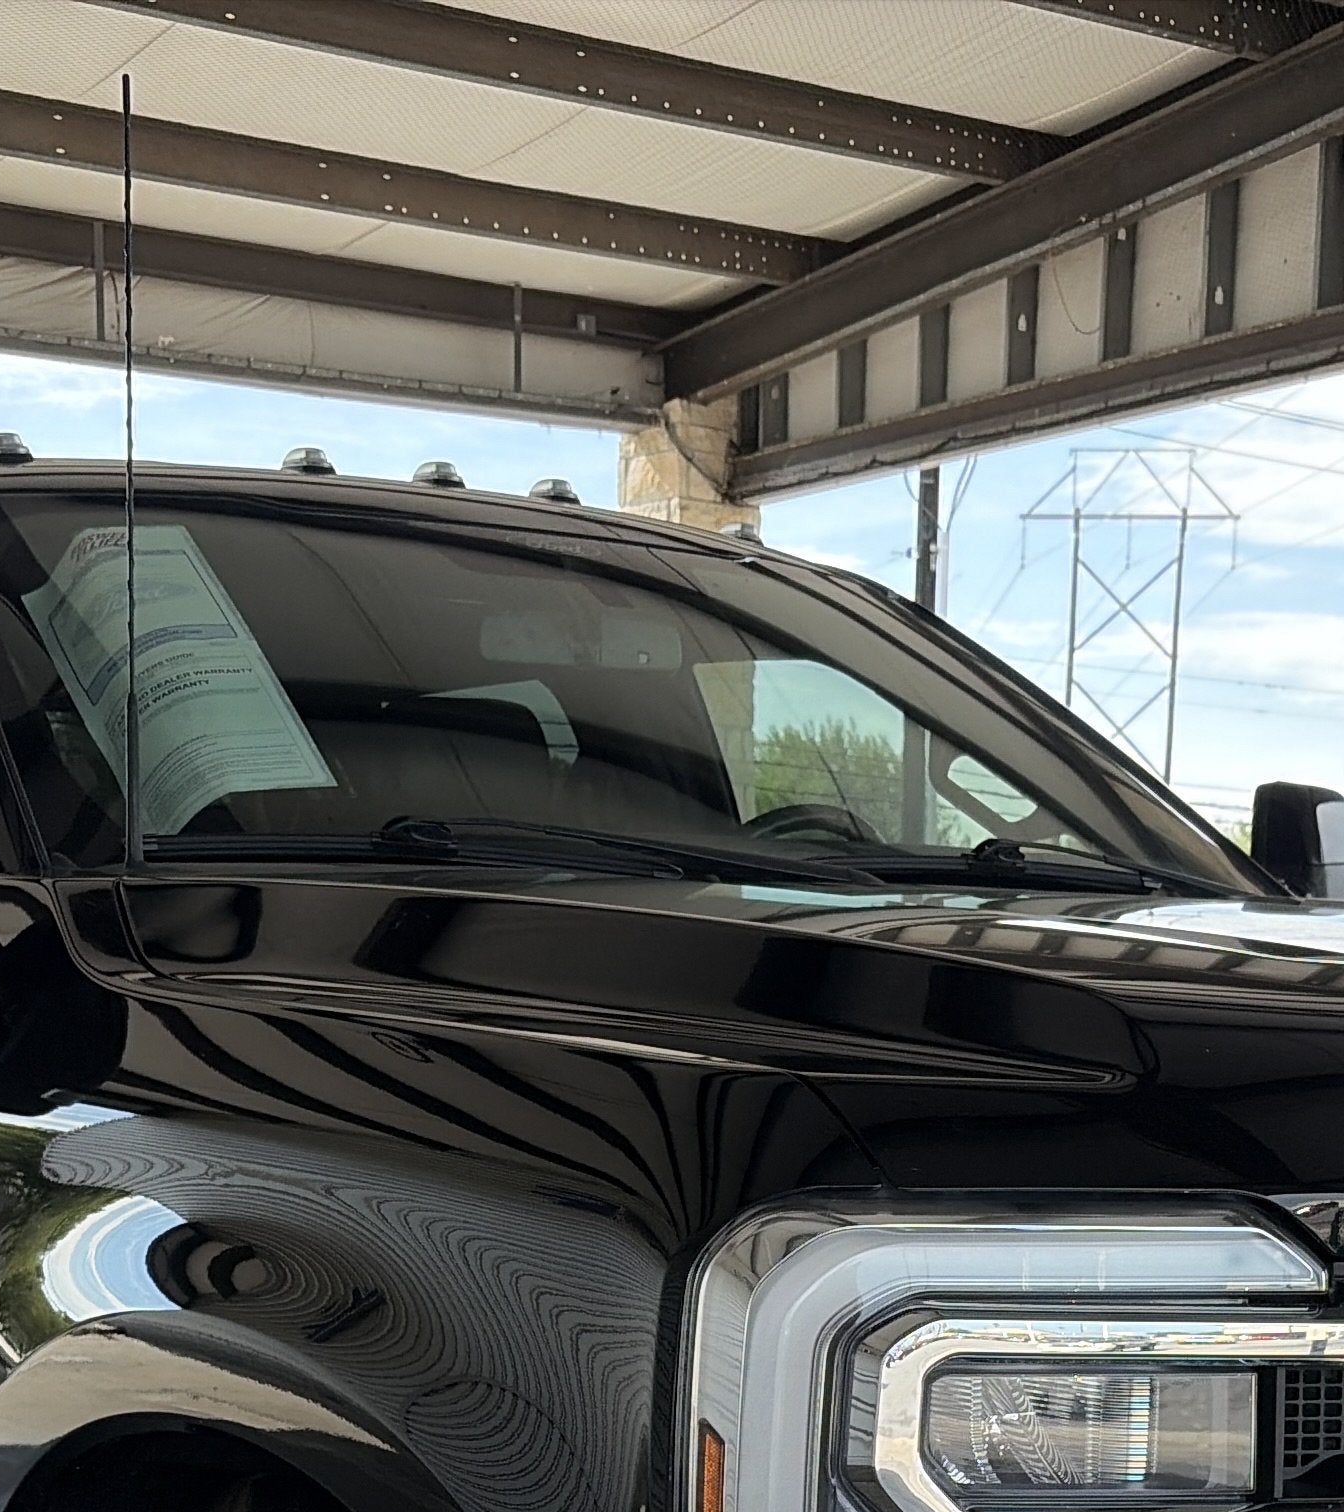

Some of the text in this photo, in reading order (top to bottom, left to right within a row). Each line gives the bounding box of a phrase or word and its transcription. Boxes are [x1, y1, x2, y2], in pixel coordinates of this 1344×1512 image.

[150, 672, 191, 693] DEALER
[193, 668, 253, 676] WARRANTY
[152, 680, 209, 703] WARRANTY
